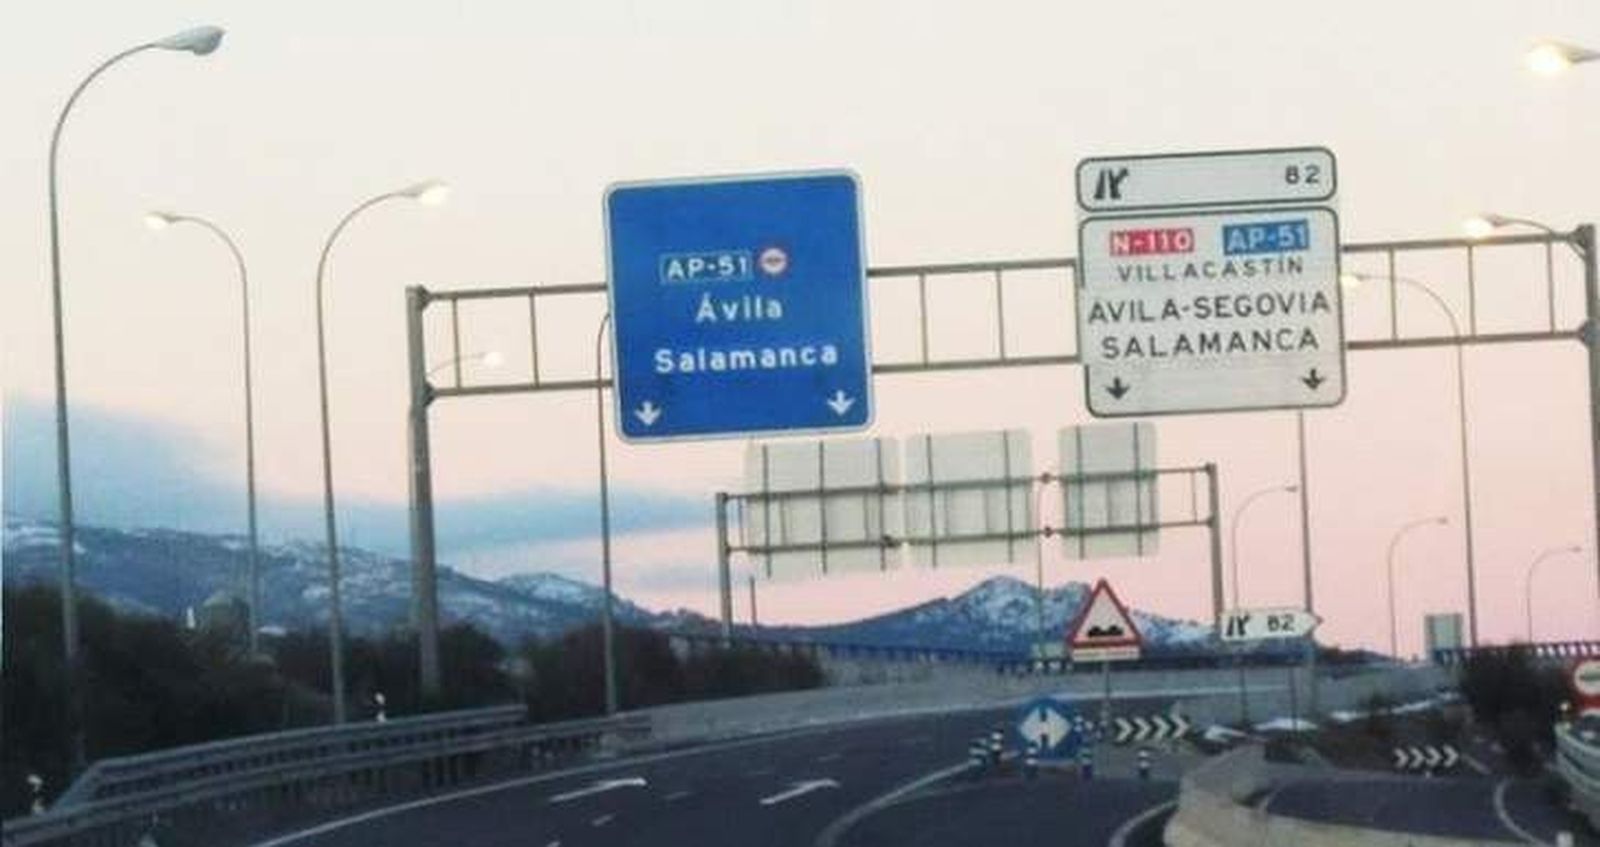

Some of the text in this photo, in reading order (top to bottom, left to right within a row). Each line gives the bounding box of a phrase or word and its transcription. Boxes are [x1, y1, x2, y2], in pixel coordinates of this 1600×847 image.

[1284, 165, 1321, 185] 82
[1111, 230, 1193, 253] N-110
[1226, 222, 1307, 251] AP-51
[667, 255, 747, 279] AP-51
[696, 293, 783, 322] Ávila
[1102, 327, 1320, 360] SALAMANCA
[655, 344, 839, 373] Salamanca
[1267, 613, 1295, 632] 82
